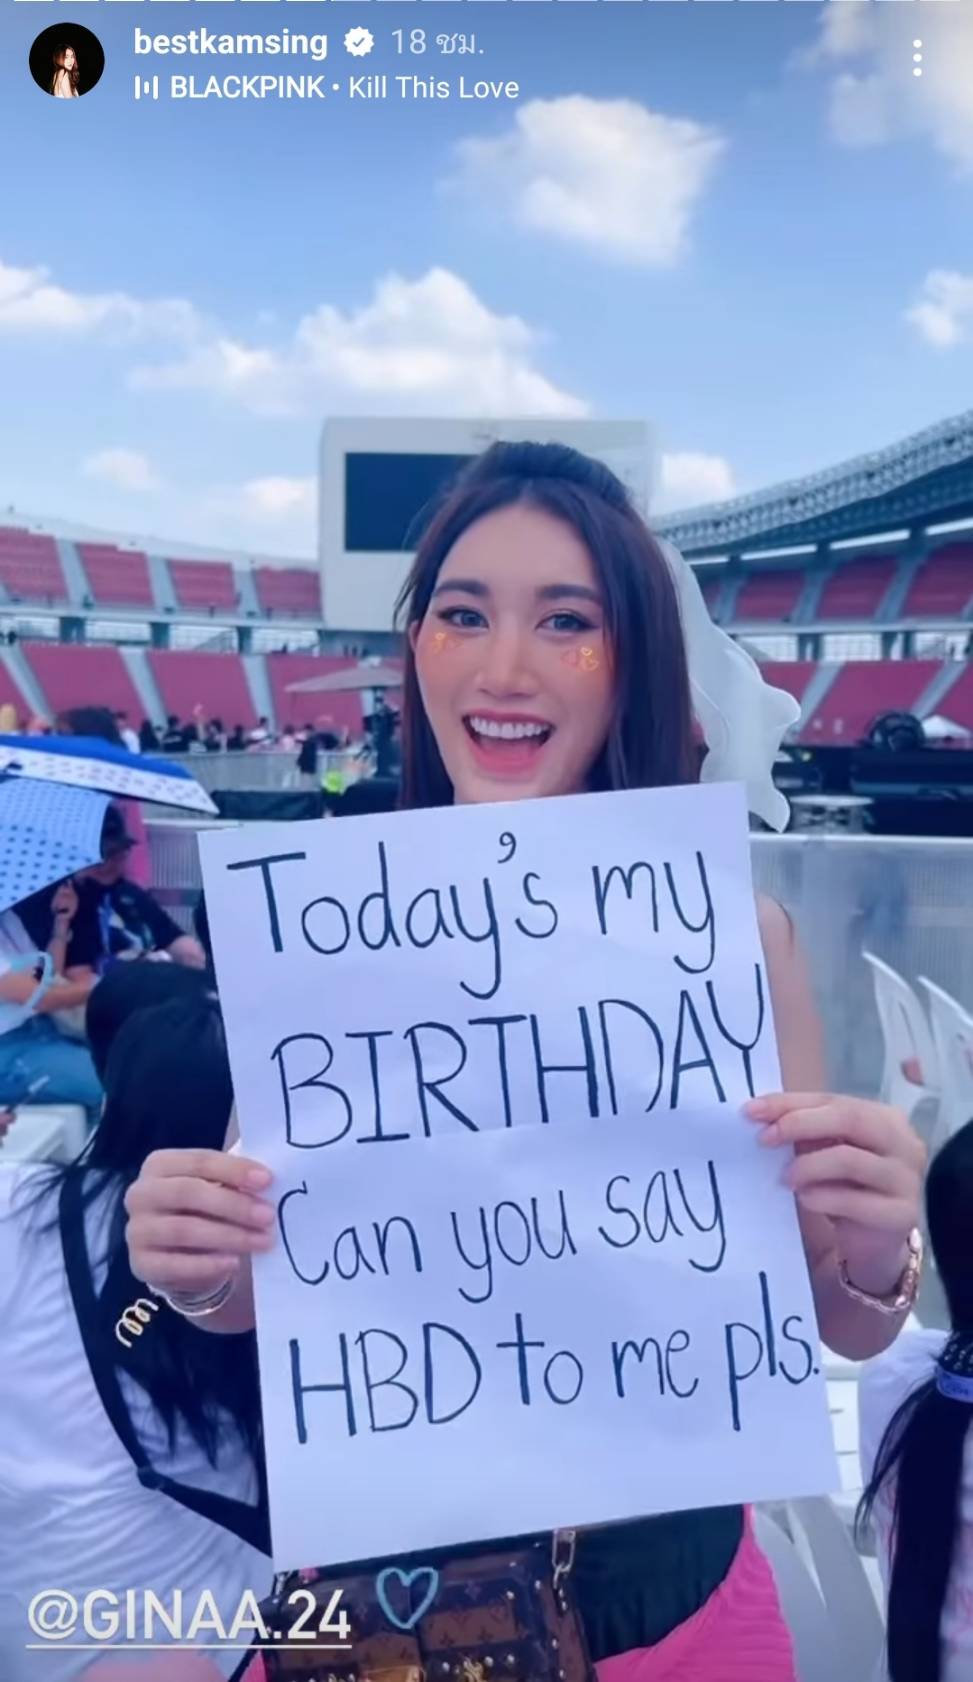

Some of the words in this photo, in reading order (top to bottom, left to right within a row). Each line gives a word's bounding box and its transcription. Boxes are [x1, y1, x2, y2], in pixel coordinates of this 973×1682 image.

[226, 831, 559, 999] Today's
[592, 851, 716, 974] my
[270, 963, 765, 1148] BIRTHDAY
[277, 1180, 422, 1285] Can
[451, 1190, 577, 1303] you
[598, 1160, 726, 1273] say
[289, 1322, 482, 1444] HBD
[496, 1313, 584, 1405] to
[611, 1330, 699, 1399] me
[725, 1271, 820, 1431] pls.
